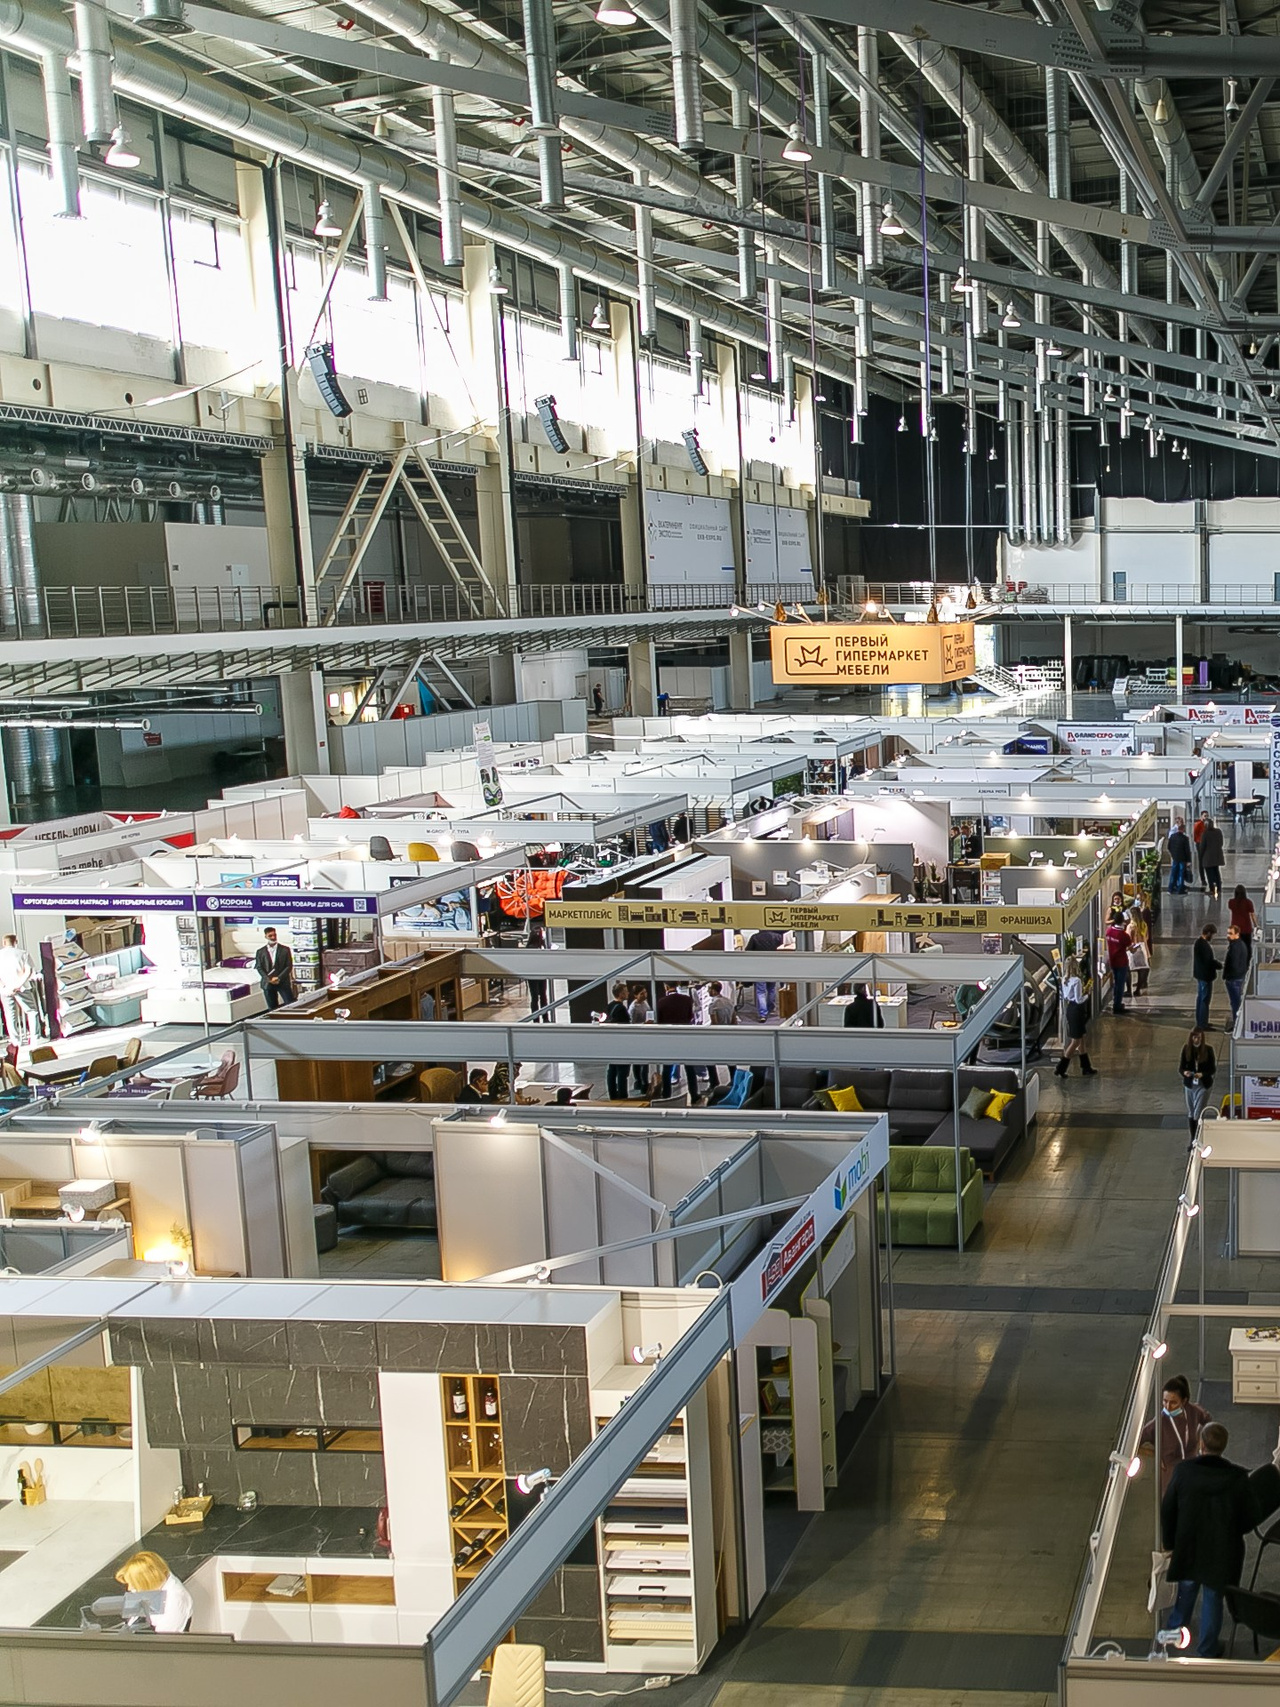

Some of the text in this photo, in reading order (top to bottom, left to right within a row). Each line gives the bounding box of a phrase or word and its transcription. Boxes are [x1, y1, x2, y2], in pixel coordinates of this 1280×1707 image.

[836, 634, 889, 647] ПЕРВЫЙ
[836, 650, 929, 661] ГИПЕРМАРКЕТ
[837, 664, 890, 675] МЕБЕЛИ
[219, 898, 253, 906] КОРОНА
[548, 908, 613, 920] МАРКЕТПЛЕЙС
[790, 906, 819, 914] ПЕРВЫЙ
[790, 914, 839, 922] ГИПЕРМАРКЕТ
[1000, 915, 1052, 925] ФРАНШИЗА
[848, 1142, 870, 1190] mobi
[783, 1224, 814, 1268] Авангард
